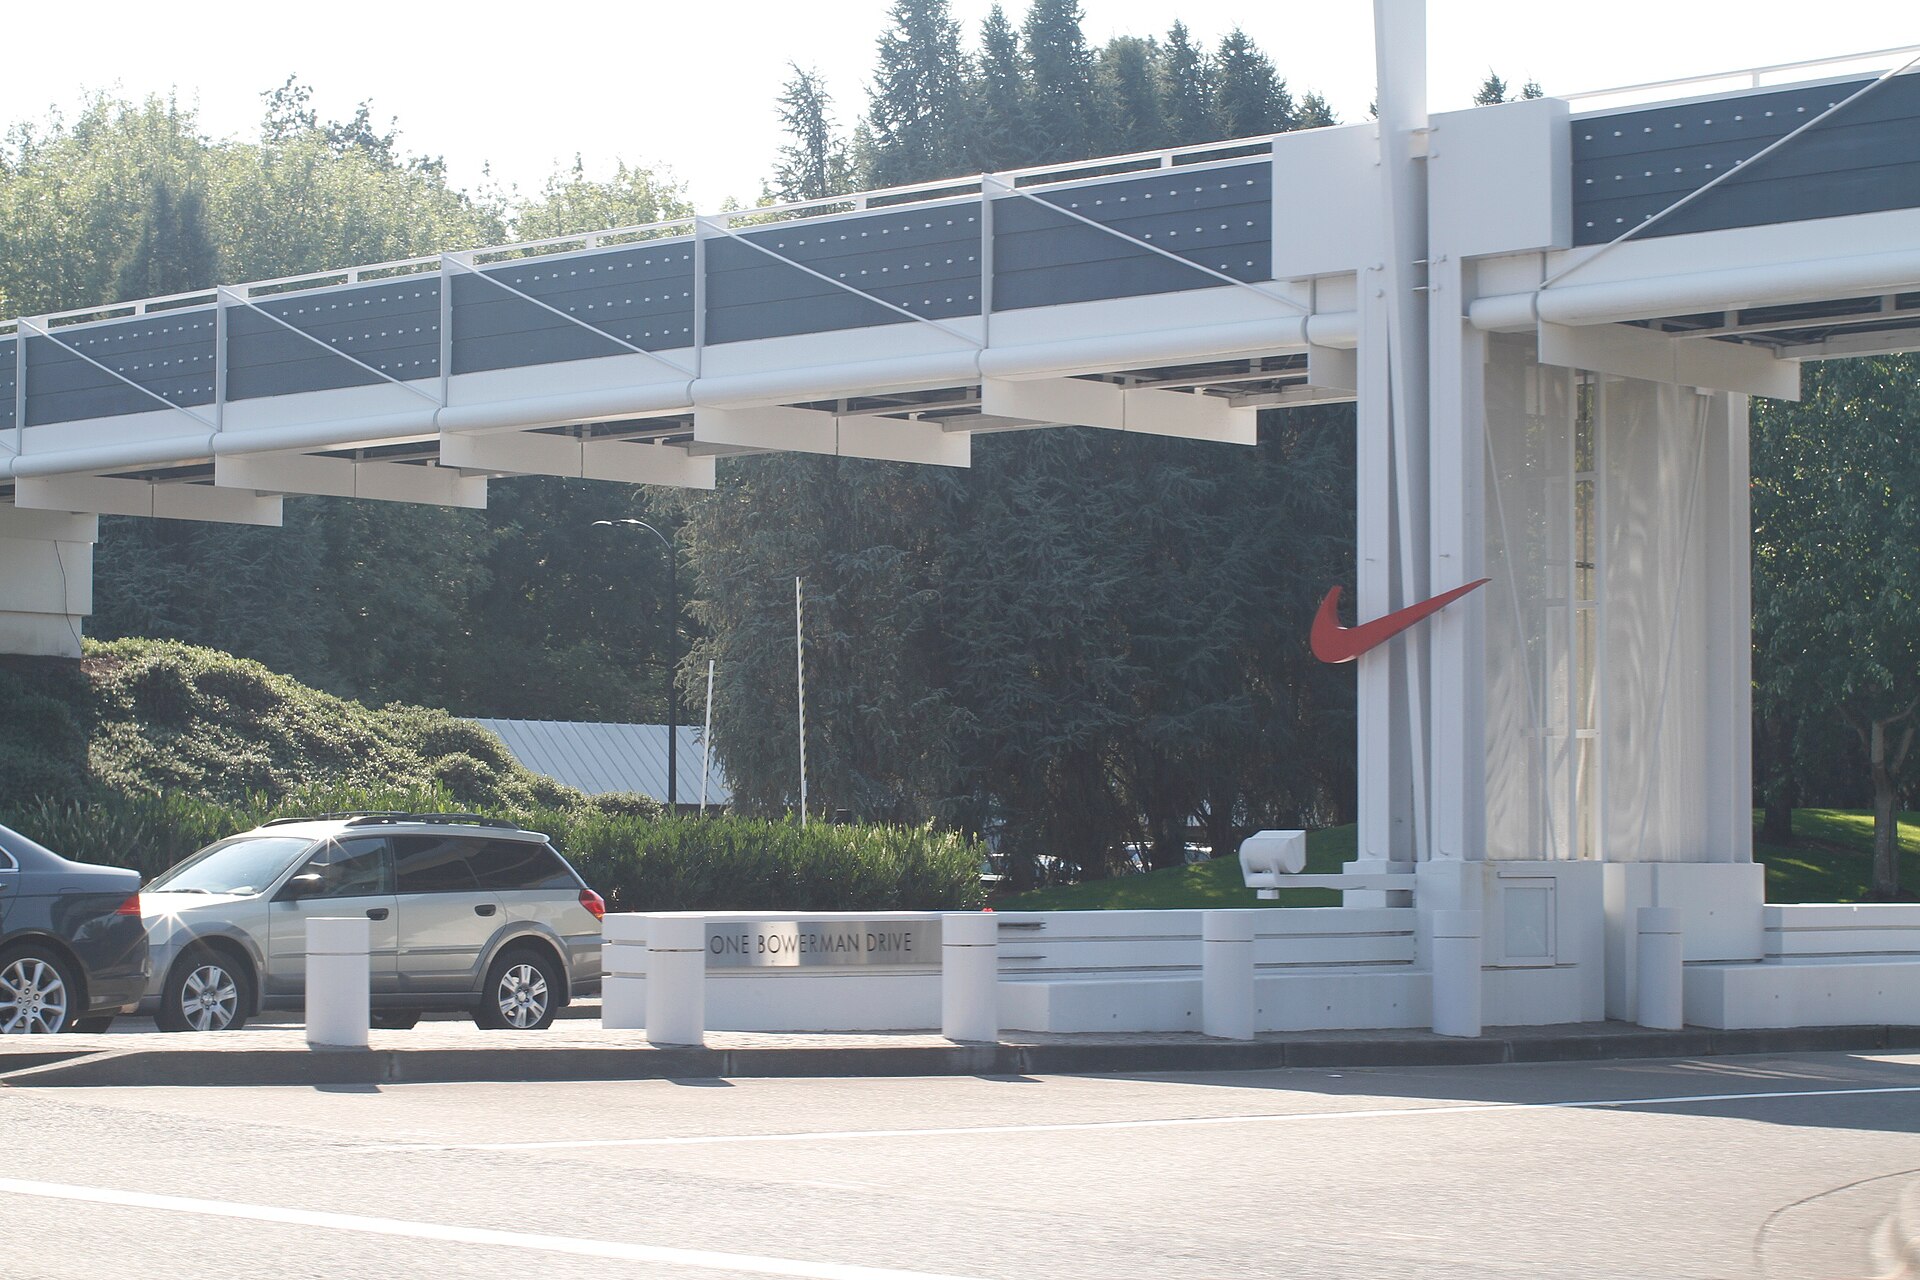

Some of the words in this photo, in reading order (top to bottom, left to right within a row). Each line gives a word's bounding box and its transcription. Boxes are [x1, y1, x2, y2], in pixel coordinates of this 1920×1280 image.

[710, 935, 749, 954] ONE
[758, 933, 859, 953] BOWERMAN
[867, 932, 911, 952] DRIVE
